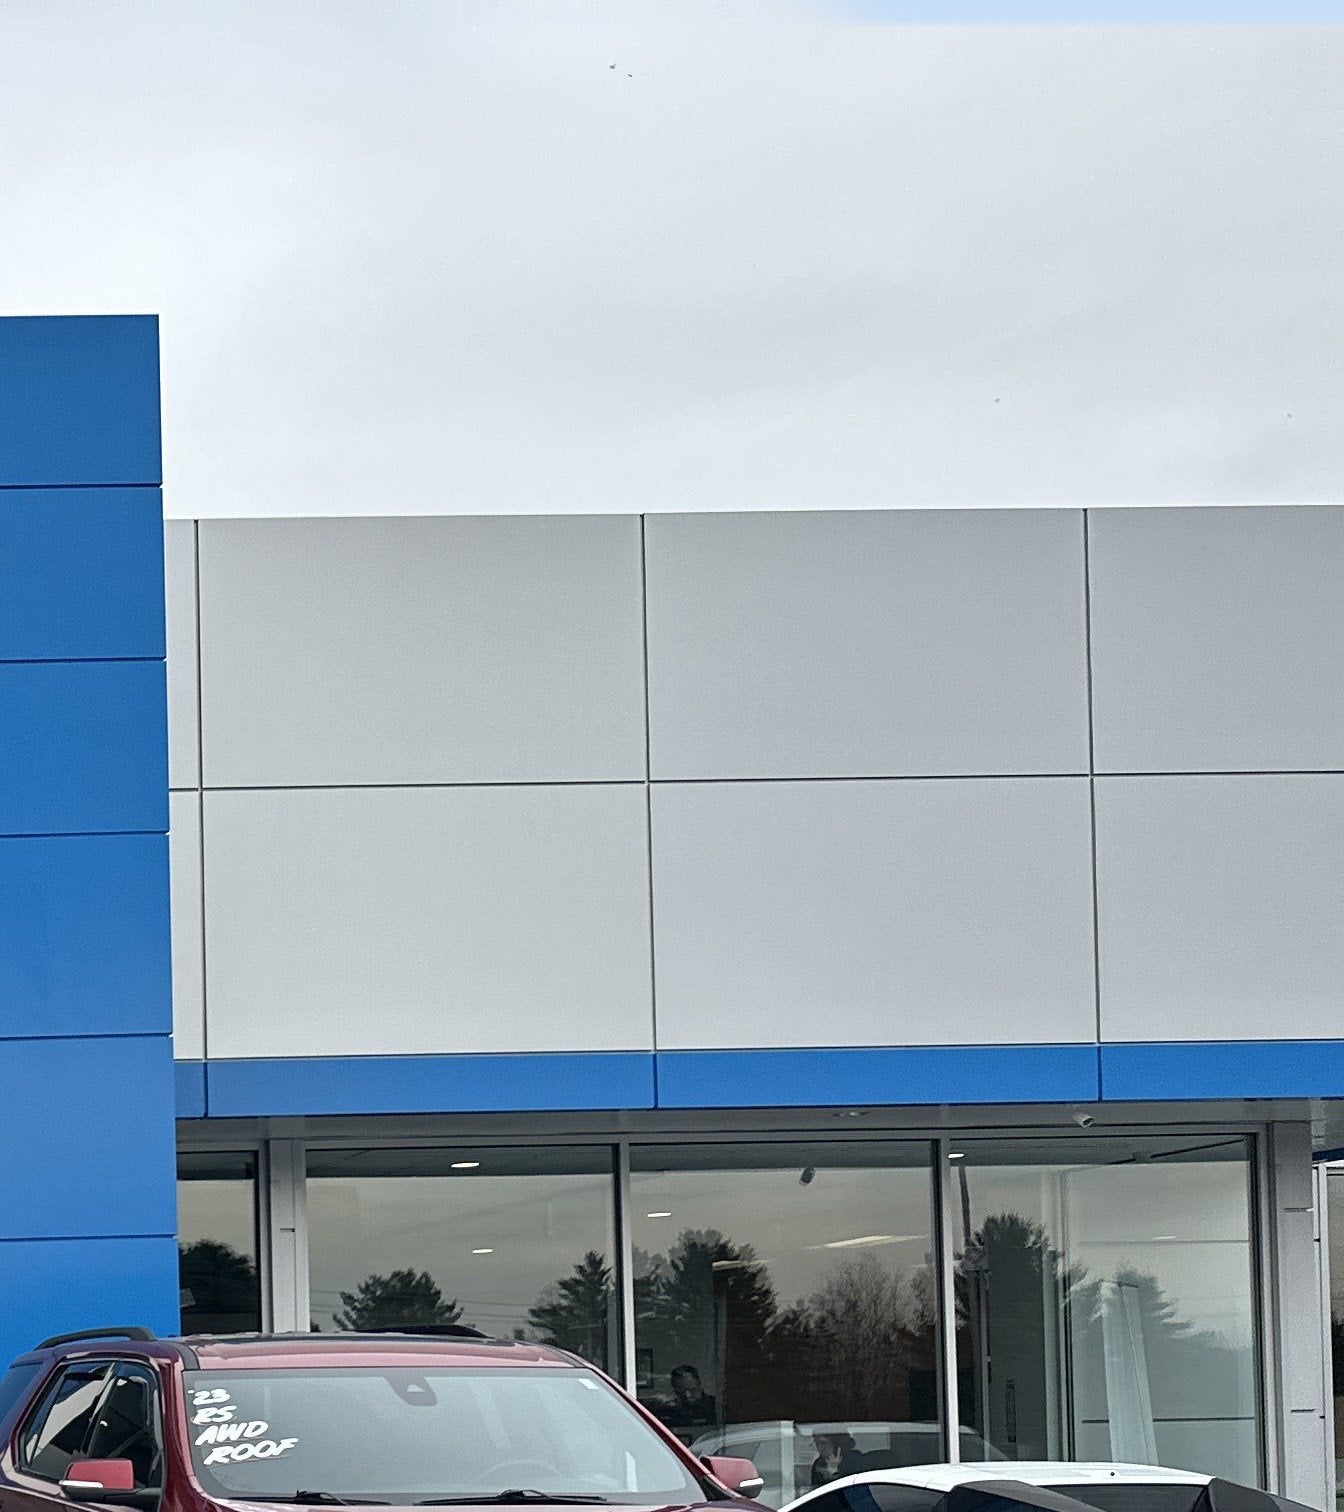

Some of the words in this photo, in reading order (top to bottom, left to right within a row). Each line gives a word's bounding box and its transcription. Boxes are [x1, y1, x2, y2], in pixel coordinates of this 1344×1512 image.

[192, 1405, 237, 1424] RS
[195, 1421, 269, 1446] AWD
[203, 1438, 299, 1465] ROOF
